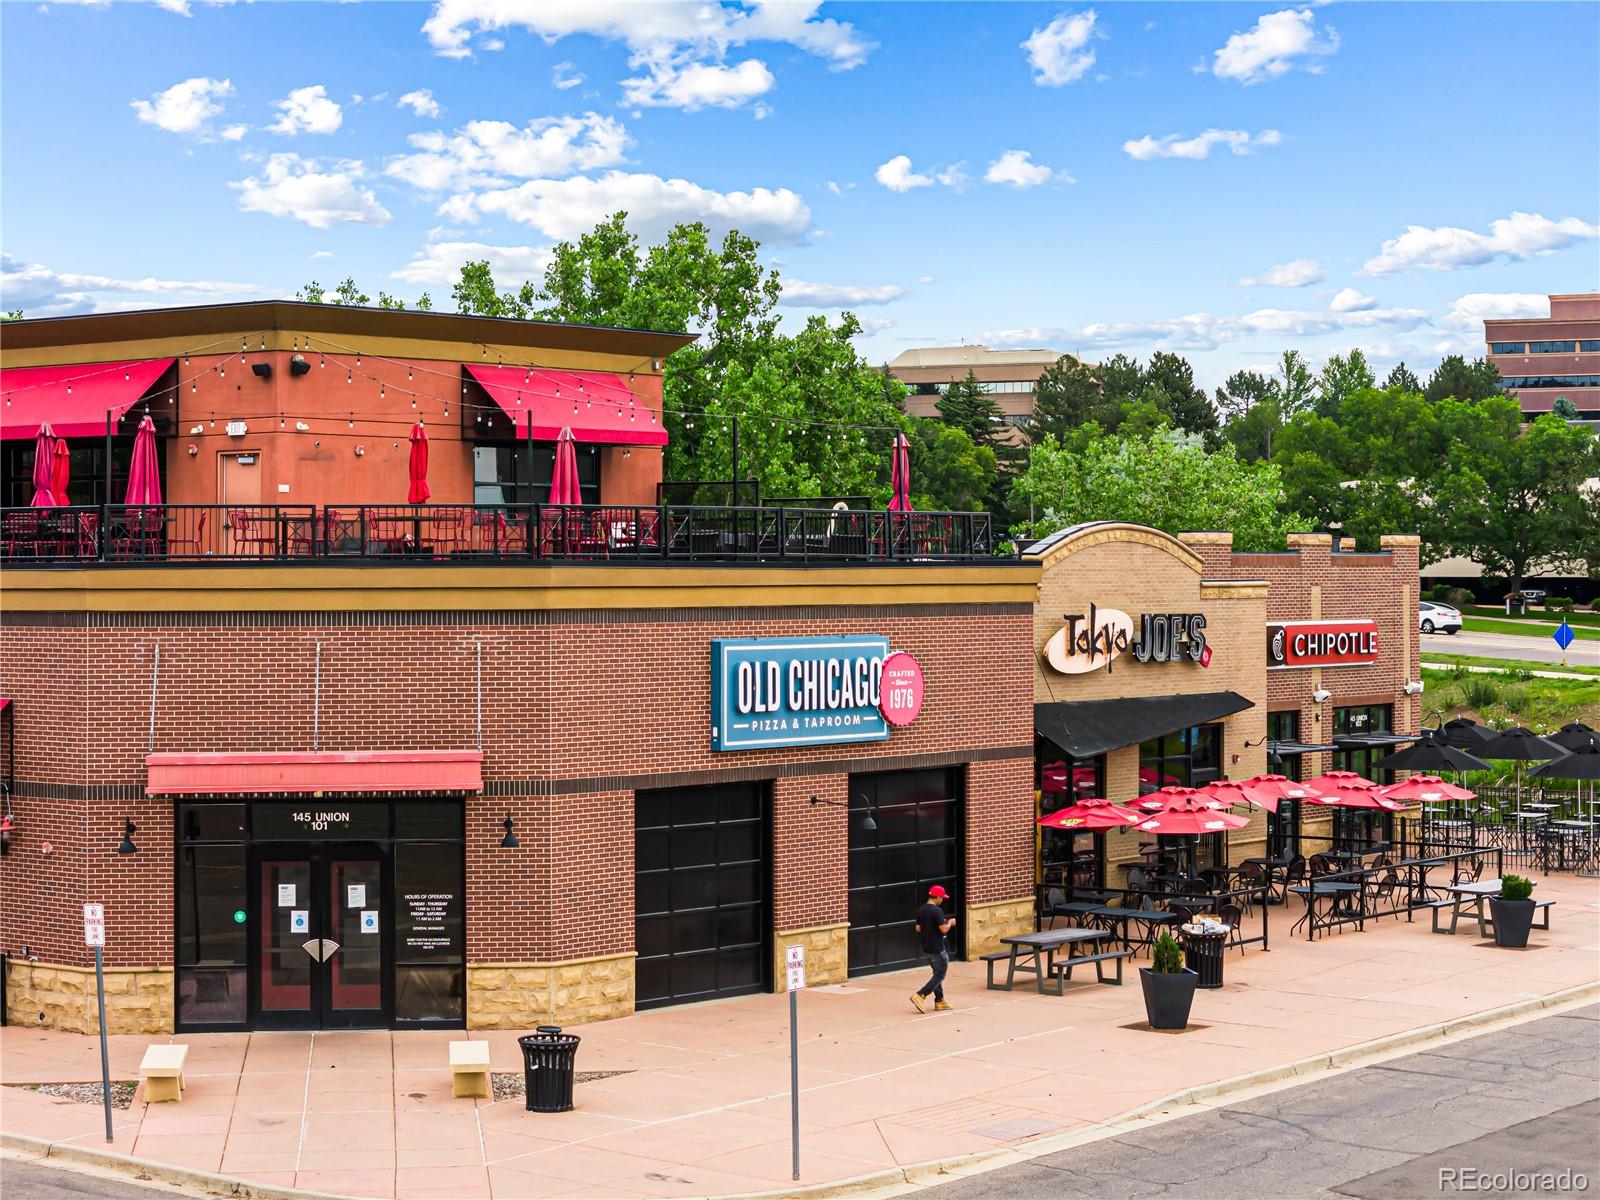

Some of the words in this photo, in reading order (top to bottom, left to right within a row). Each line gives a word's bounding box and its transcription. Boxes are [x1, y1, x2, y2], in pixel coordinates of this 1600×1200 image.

[1064, 602, 1128, 673] Tokyo
[1133, 613, 1207, 662] JOE'S
[1295, 632, 1377, 656] CHIPOTLE
[738, 661, 780, 714] OLD
[789, 656, 881, 711] CHICAGO
[890, 689, 913, 709] 1976
[752, 719, 787, 732] PIZZA
[793, 716, 799, 729] &
[805, 714, 861, 728] TAPROOM
[292, 812, 311, 822] 145
[315, 812, 350, 822] UNION
[311, 821, 328, 831] 101
[787, 960, 803, 969] PARKING
[792, 951, 798, 960] NO
